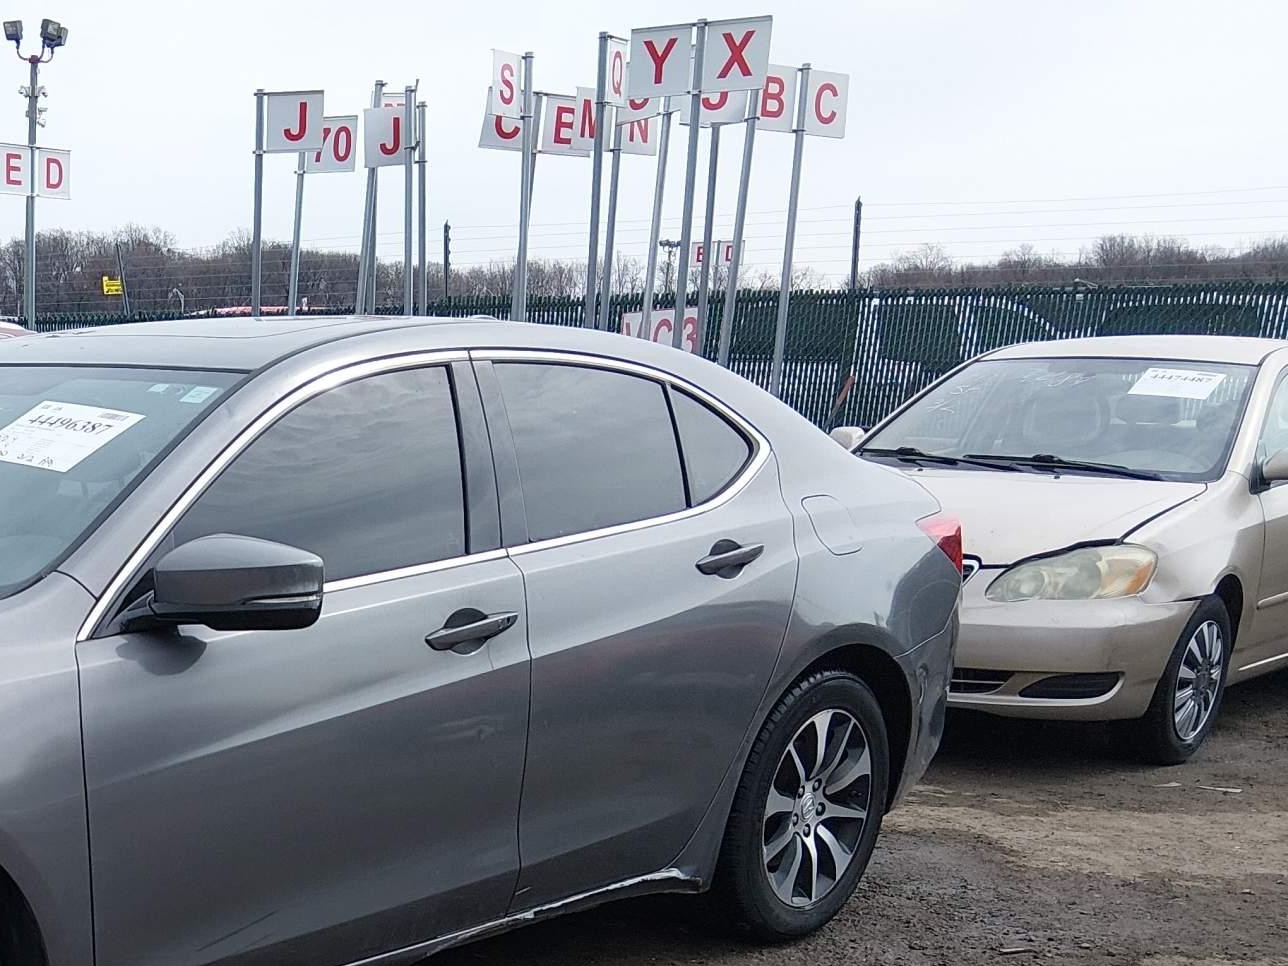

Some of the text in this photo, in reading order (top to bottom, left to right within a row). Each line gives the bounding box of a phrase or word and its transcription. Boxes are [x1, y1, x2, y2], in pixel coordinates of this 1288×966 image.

[612, 51, 623, 97] Q
[644, 38, 678, 84] Y
[716, 31, 756, 79] X
[499, 63, 514, 106] S
[760, 76, 785, 118] B
[814, 83, 839, 124] C
[284, 101, 308, 141] J
[380, 117, 401, 156] J
[553, 106, 576, 145] E
[628, 118, 649, 145] N
[5, 153, 22, 185] E
[46, 157, 64, 189] D
[28, 414, 114, 435] 44496387
